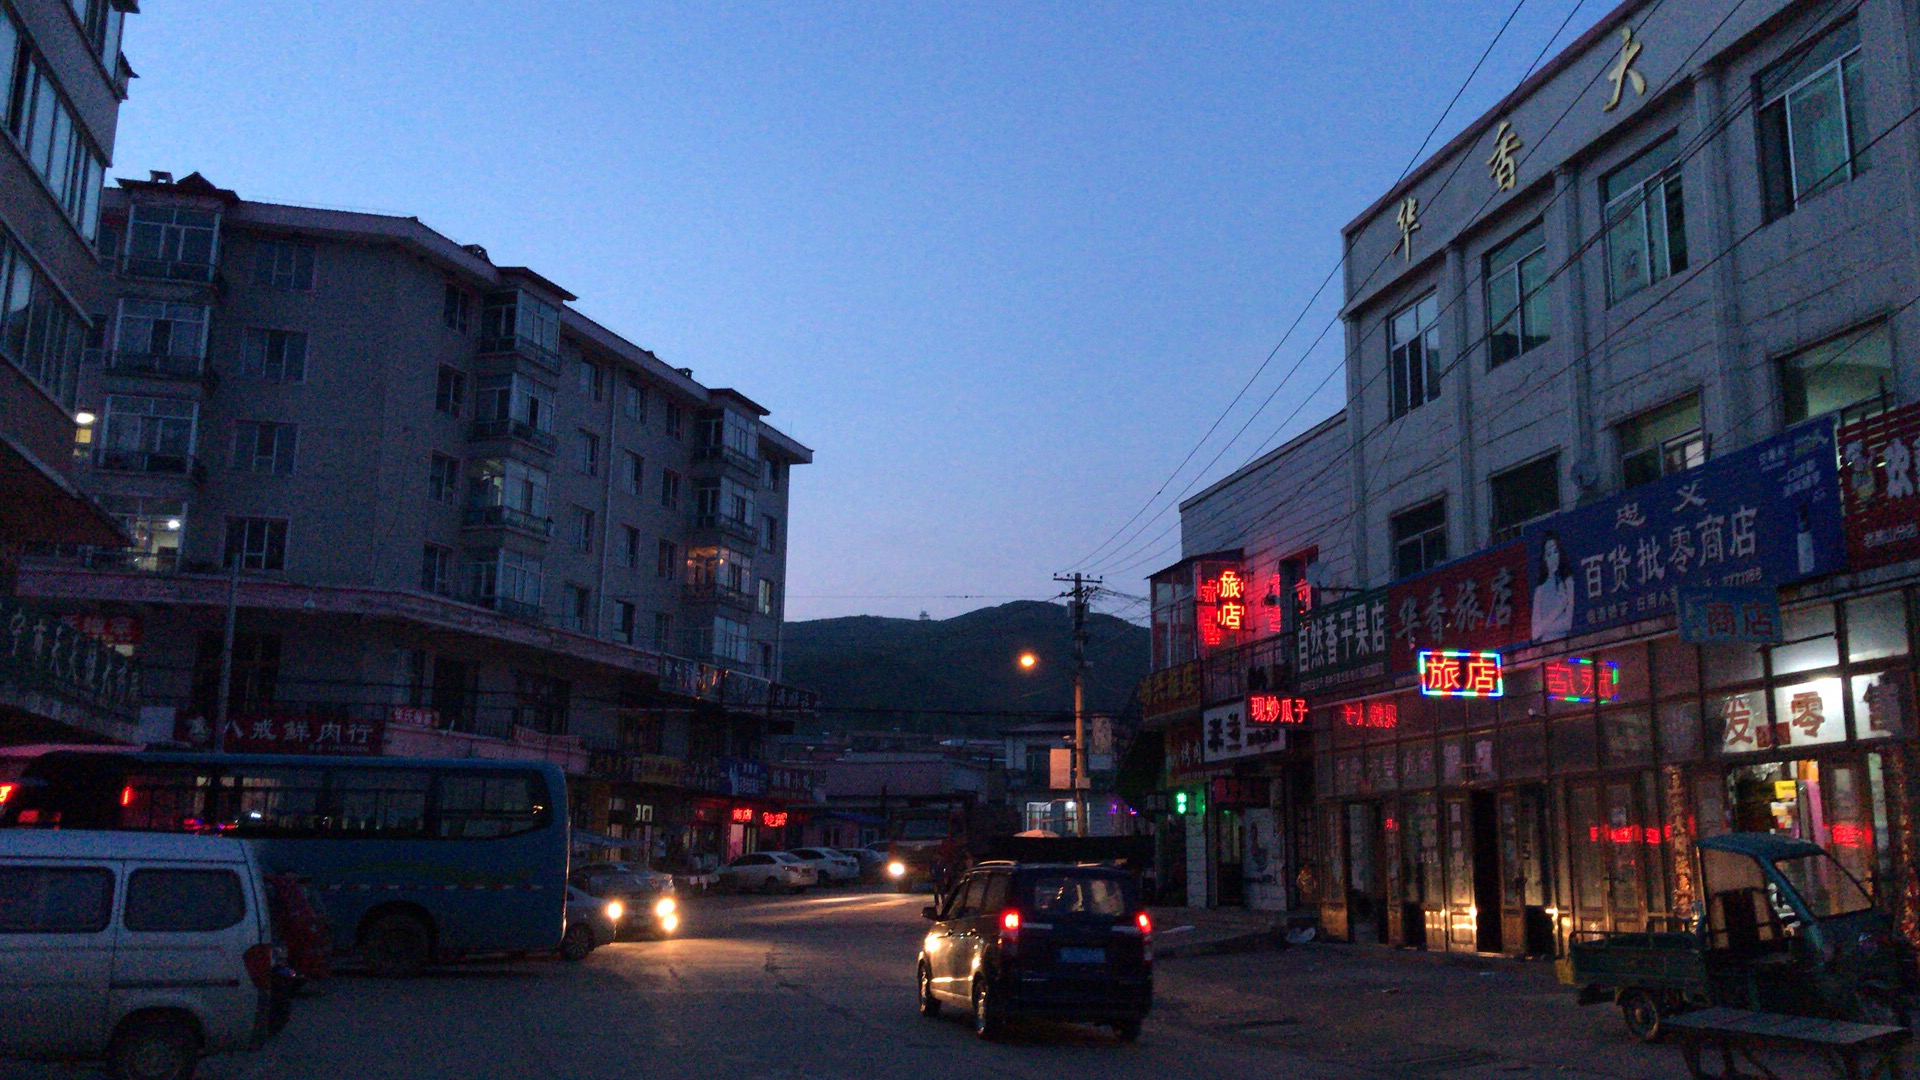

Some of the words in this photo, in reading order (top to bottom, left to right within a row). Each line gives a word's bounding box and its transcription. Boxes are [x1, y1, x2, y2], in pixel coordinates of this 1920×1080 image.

[1396, 28, 1645, 261] 华香大
[1580, 503, 1758, 599] 百货批零商店
[1220, 571, 1241, 627] 旅店
[1395, 567, 1513, 648] 华香旅店
[1707, 600, 1773, 636] 商店
[1298, 599, 1385, 672] 自然香干果店
[1426, 658, 1497, 690] 旅店
[1250, 696, 1309, 723] 现炒瓜子
